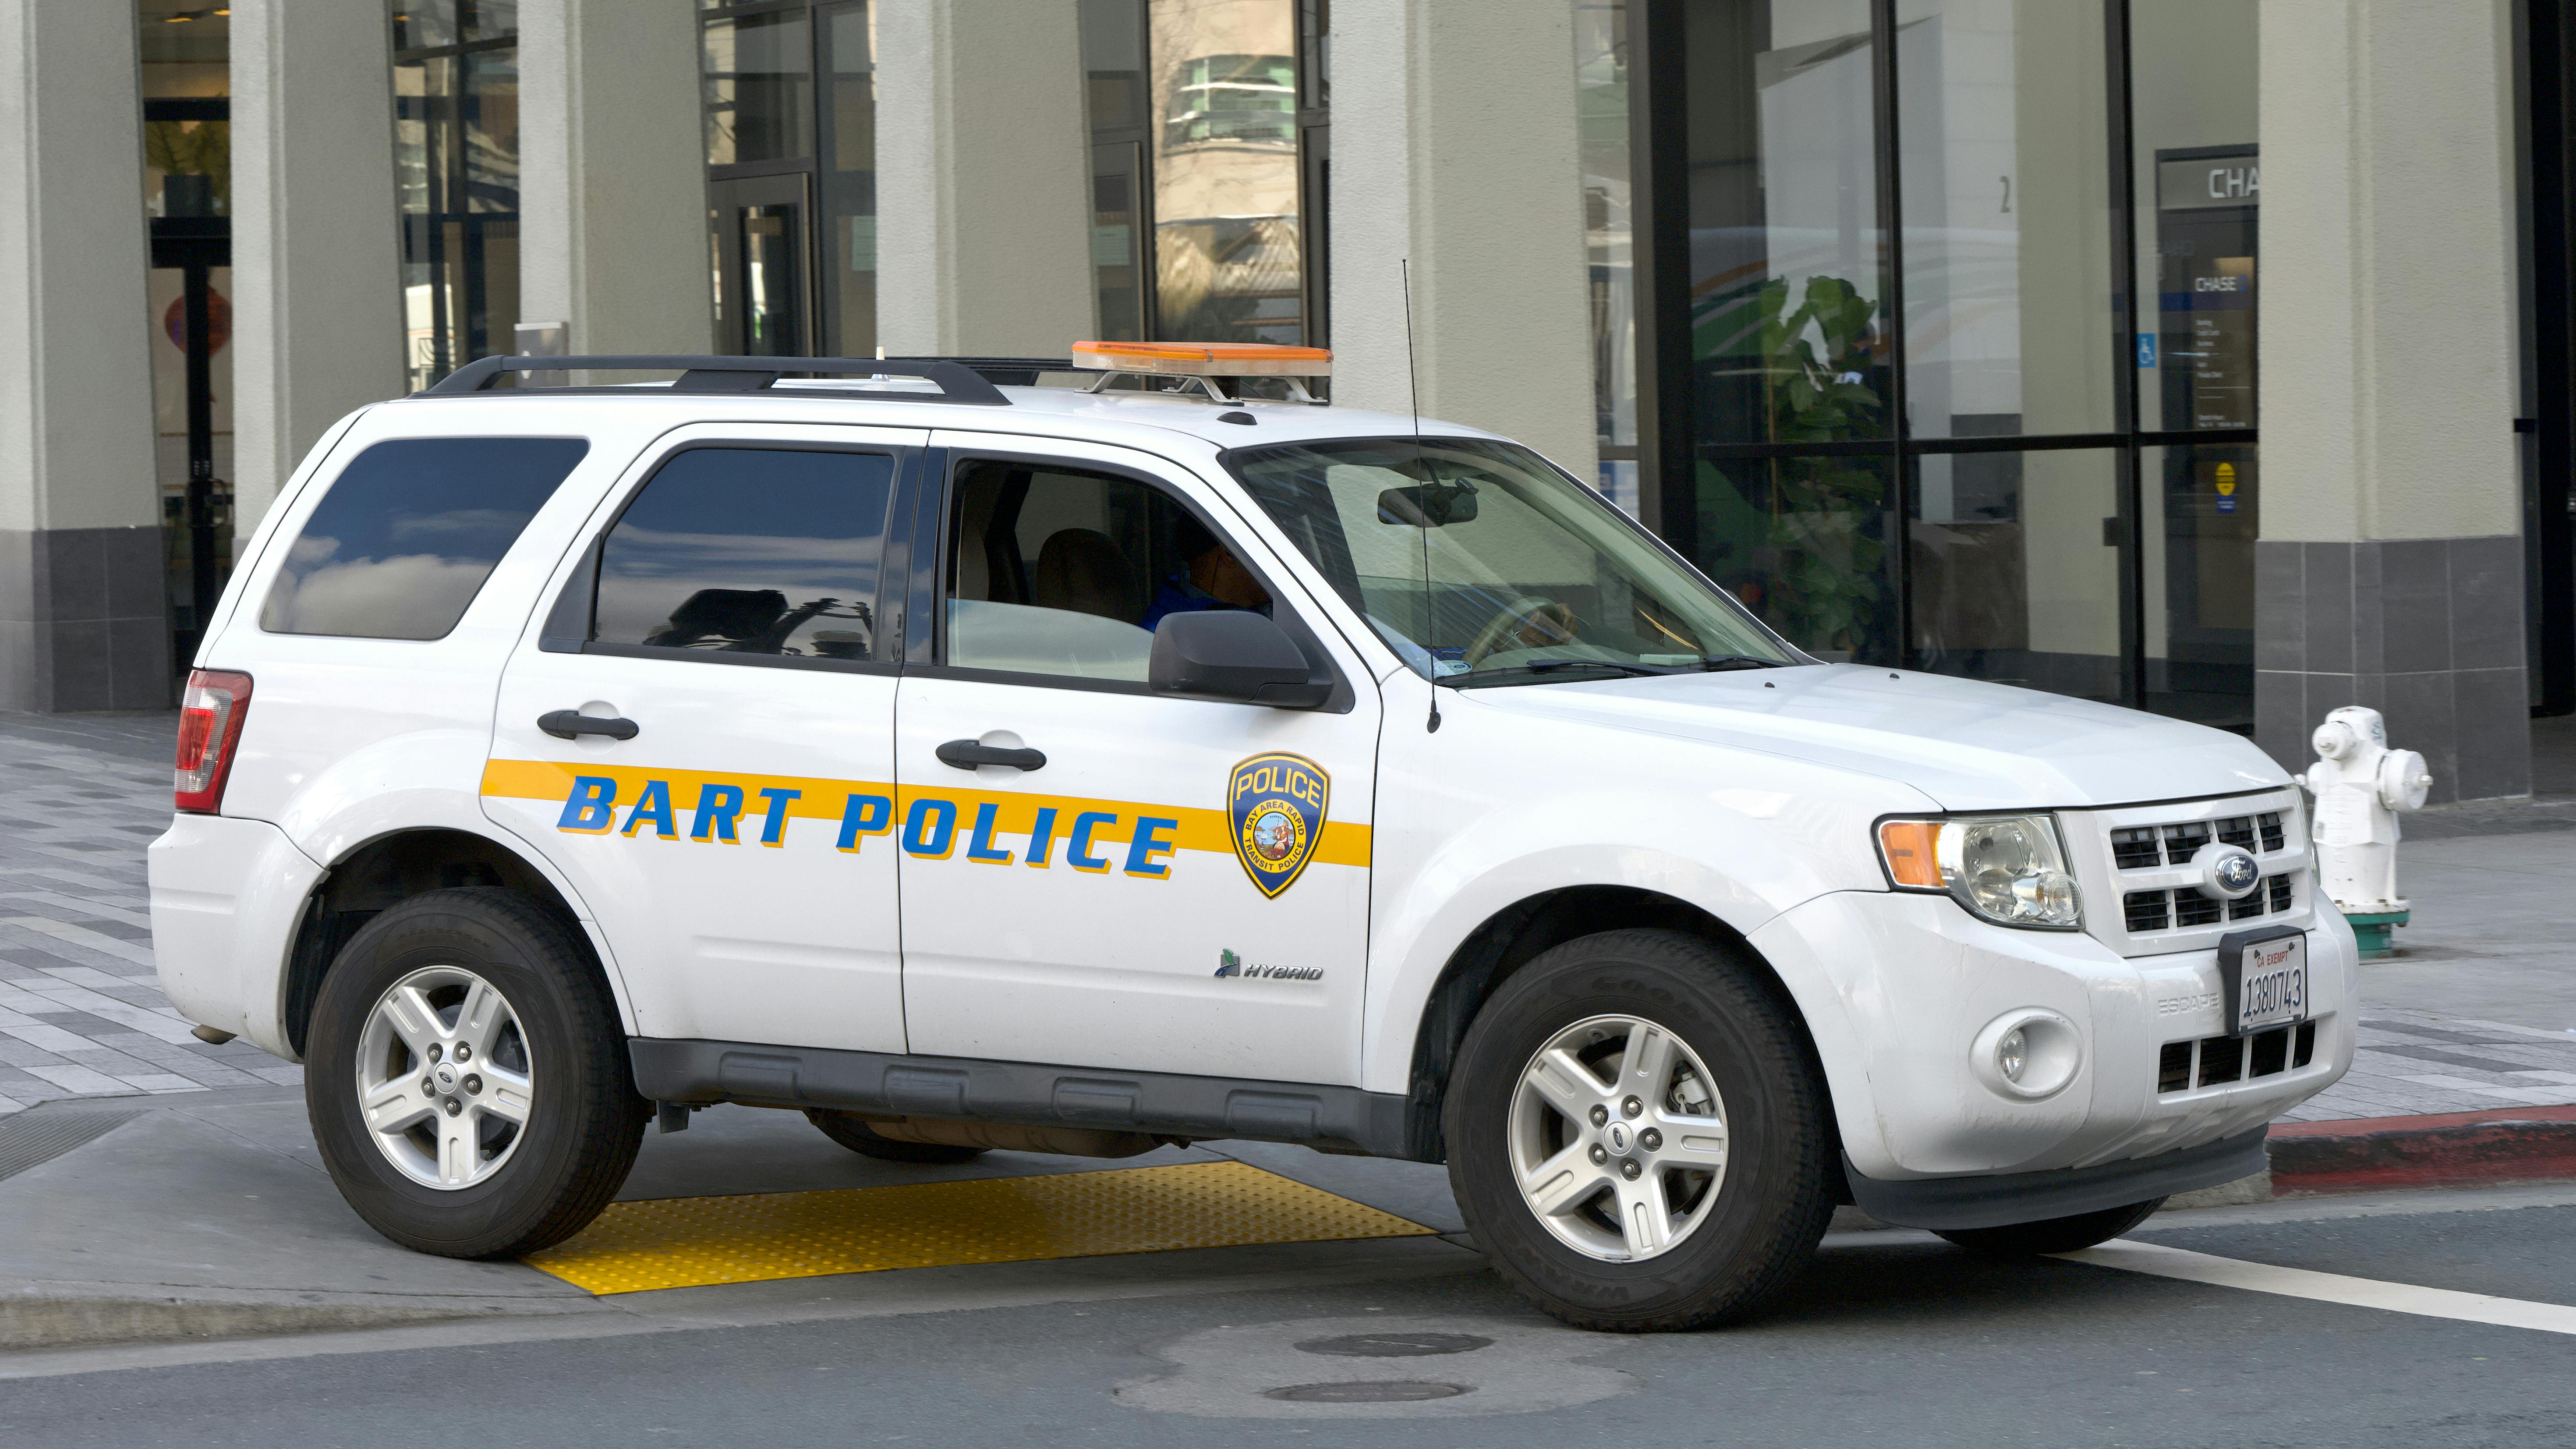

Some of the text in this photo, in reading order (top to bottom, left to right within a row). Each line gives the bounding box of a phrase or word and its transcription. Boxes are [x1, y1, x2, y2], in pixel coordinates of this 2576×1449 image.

[2209, 167, 2259, 198] CHA
[2195, 276, 2236, 292] CHASE
[1236, 766, 1321, 809] POLICE
[556, 776, 1178, 880] BART POLICE
[1246, 801, 1305, 836] BAY AREA RAPID
[1245, 837, 1304, 871] TRANSIT POLICE
[2231, 859, 2252, 882] Ford
[1244, 964, 1323, 980] HYBRID
[2257, 950, 2289, 967] CA EXEMPT
[2158, 992, 2219, 1016] ESCAPE
[2243, 967, 2301, 1017] 1380743
